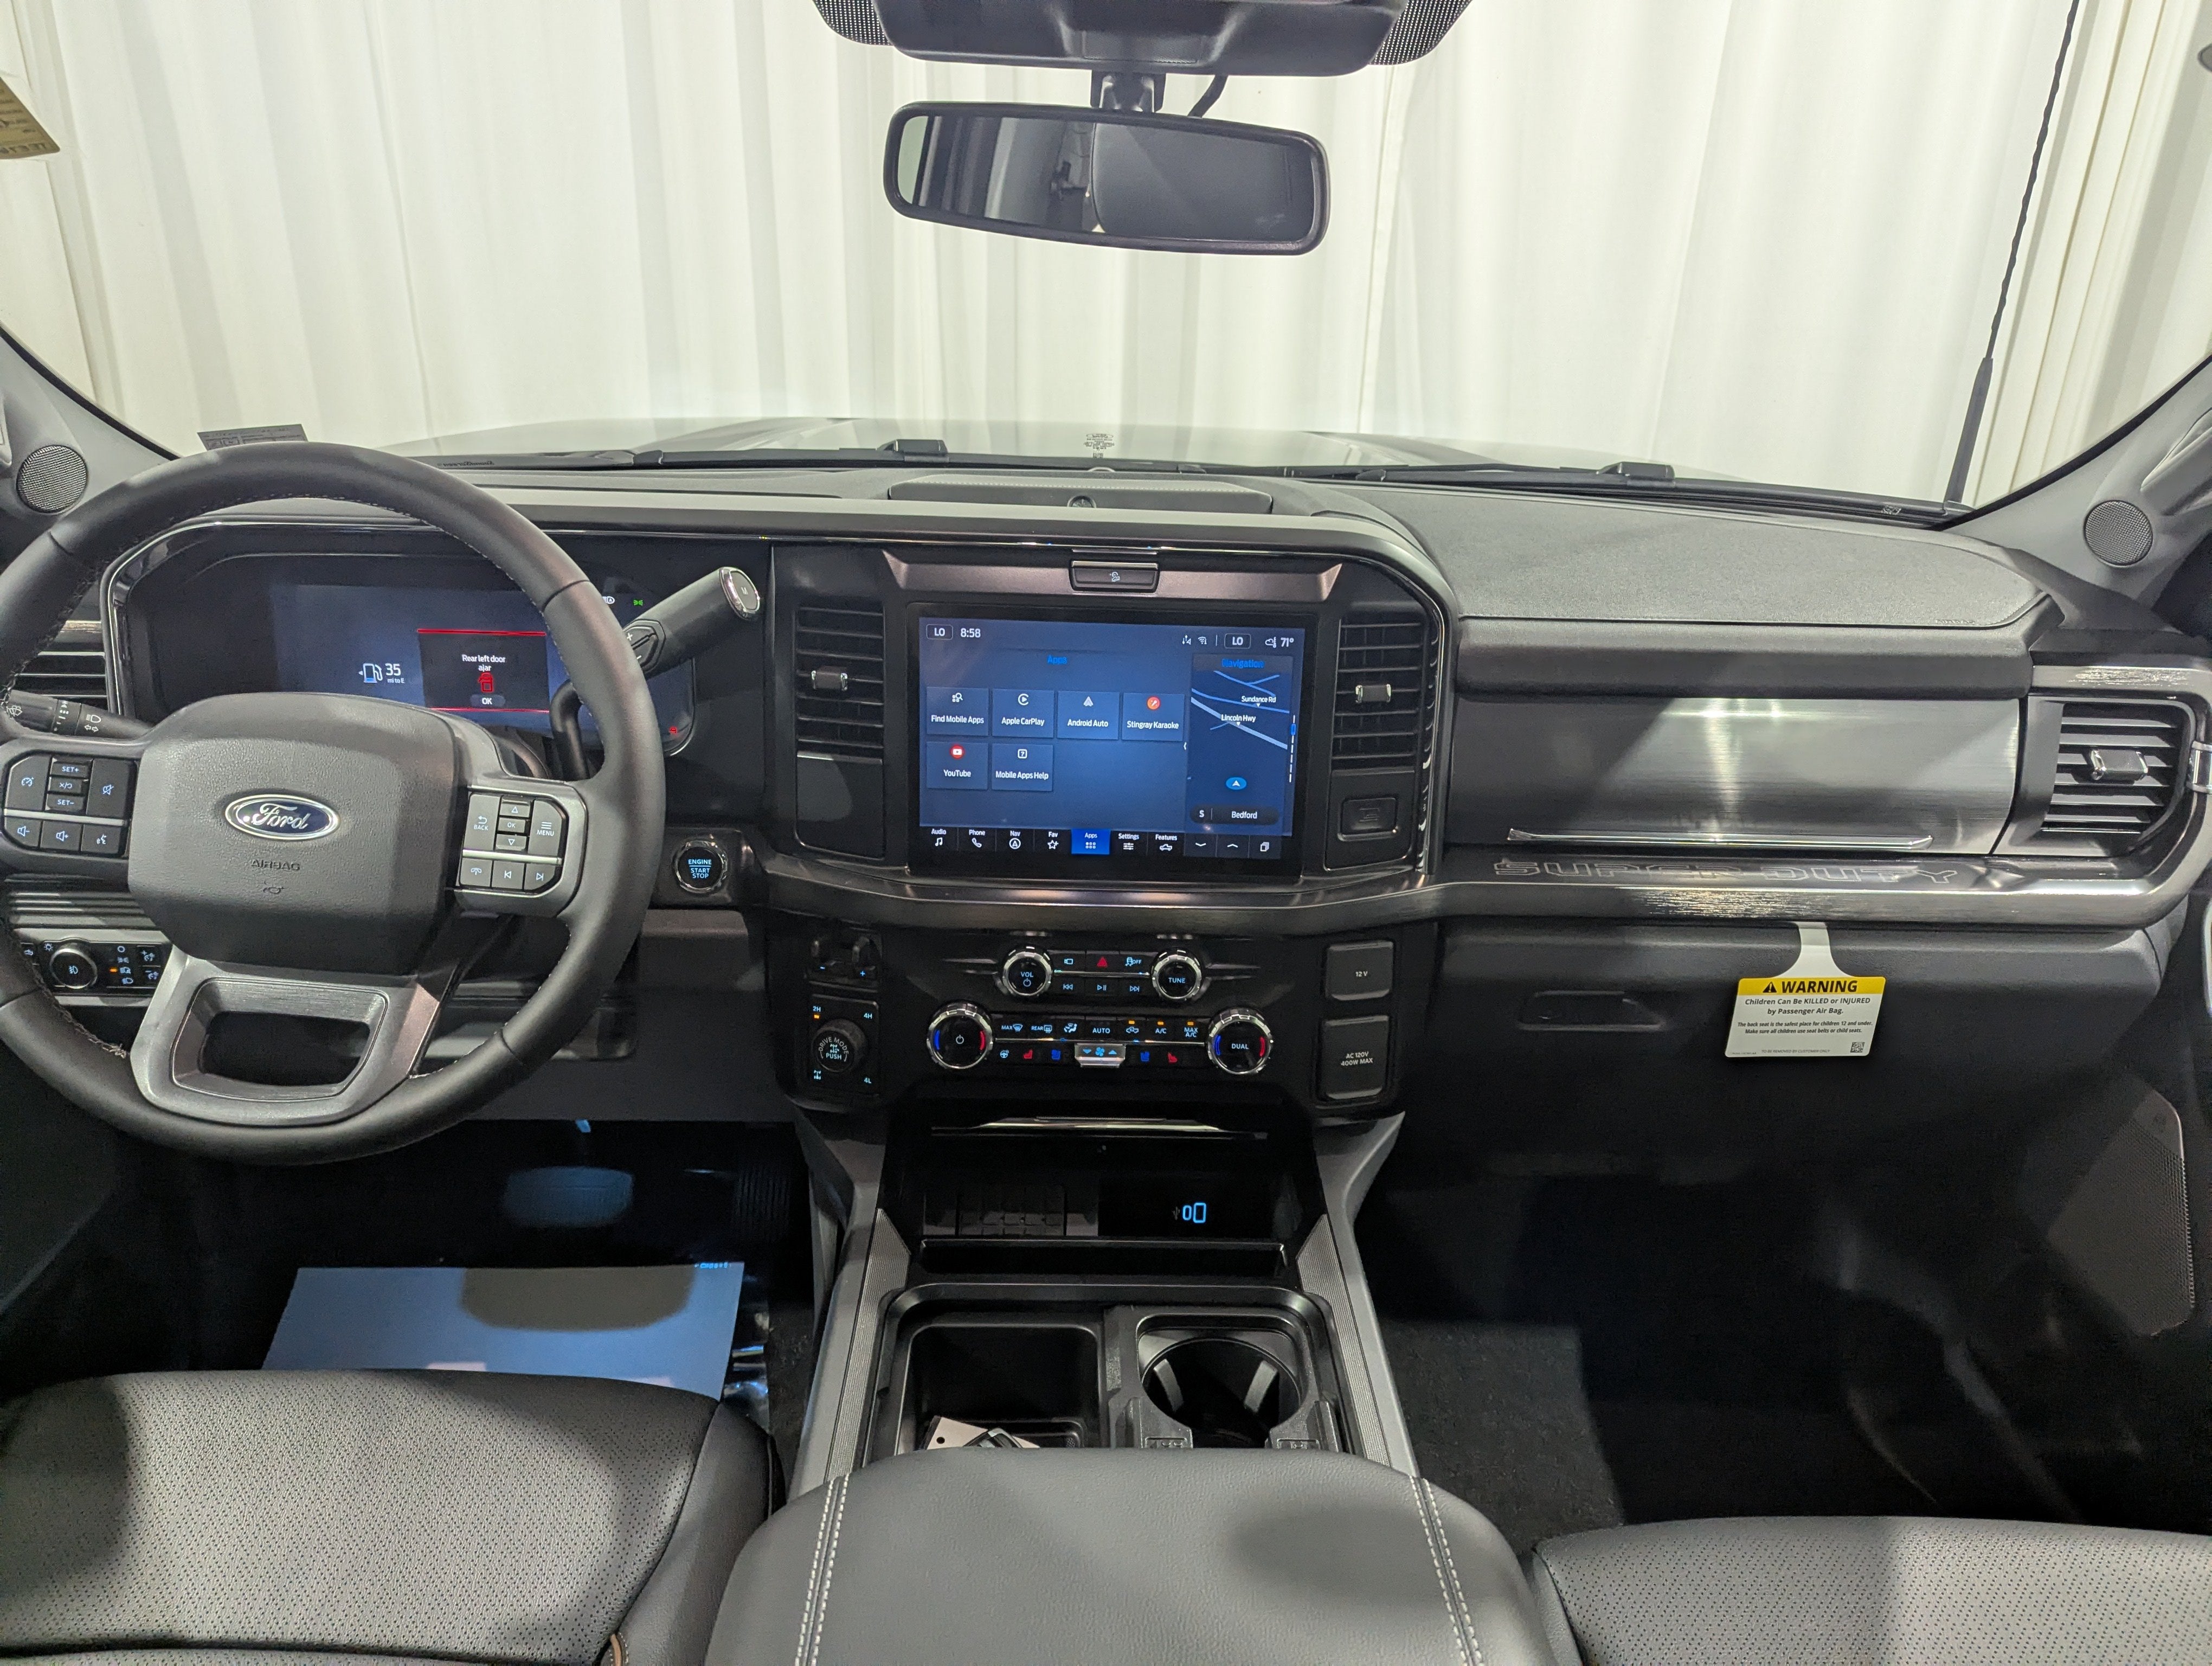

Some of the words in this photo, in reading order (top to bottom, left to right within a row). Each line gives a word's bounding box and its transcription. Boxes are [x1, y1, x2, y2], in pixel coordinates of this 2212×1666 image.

[934, 627, 946, 637] LO
[960, 627, 981, 638] 8:58
[1232, 636, 1244, 645] LO
[461, 654, 477, 662] Rear
[478, 654, 490, 663] left
[490, 655, 506, 663] door
[1047, 655, 1067, 665] Apps
[1221, 658, 1265, 668] Navigation
[385, 663, 401, 676] 35
[478, 664, 491, 672] ajar
[931, 714, 945, 723] Find
[946, 715, 967, 723] Mobile
[968, 715, 984, 724] Apps
[1001, 716, 1020, 726] Apple
[1020, 717, 1045, 727] CarPlay
[1067, 719, 1092, 727] Android
[1092, 719, 1109, 727] Auto
[1221, 714, 1242, 722] Lincoln
[1243, 714, 1256, 723] Hwy
[1127, 720, 1153, 729] Stingray
[1153, 721, 1179, 729] Karaoke
[943, 769, 972, 778] YouTube
[995, 770, 1017, 779] Mobile
[1017, 771, 1033, 780] Apps
[1033, 772, 1049, 780] Help
[251, 802, 312, 830] Ford
[1199, 809, 1205, 818] S
[1231, 810, 1258, 819] Bedford
[251, 859, 301, 871] AIRBAG
[1494, 861, 1741, 880] SUPER
[1760, 866, 1958, 884] DUTY
[1781, 980, 1858, 994] WARNING
[1778, 1008, 1815, 1016] Passenger
[818, 1036, 833, 1052] DRIVE
[834, 1036, 850, 1055] MODE
[826, 1052, 842, 1060] PUSH
